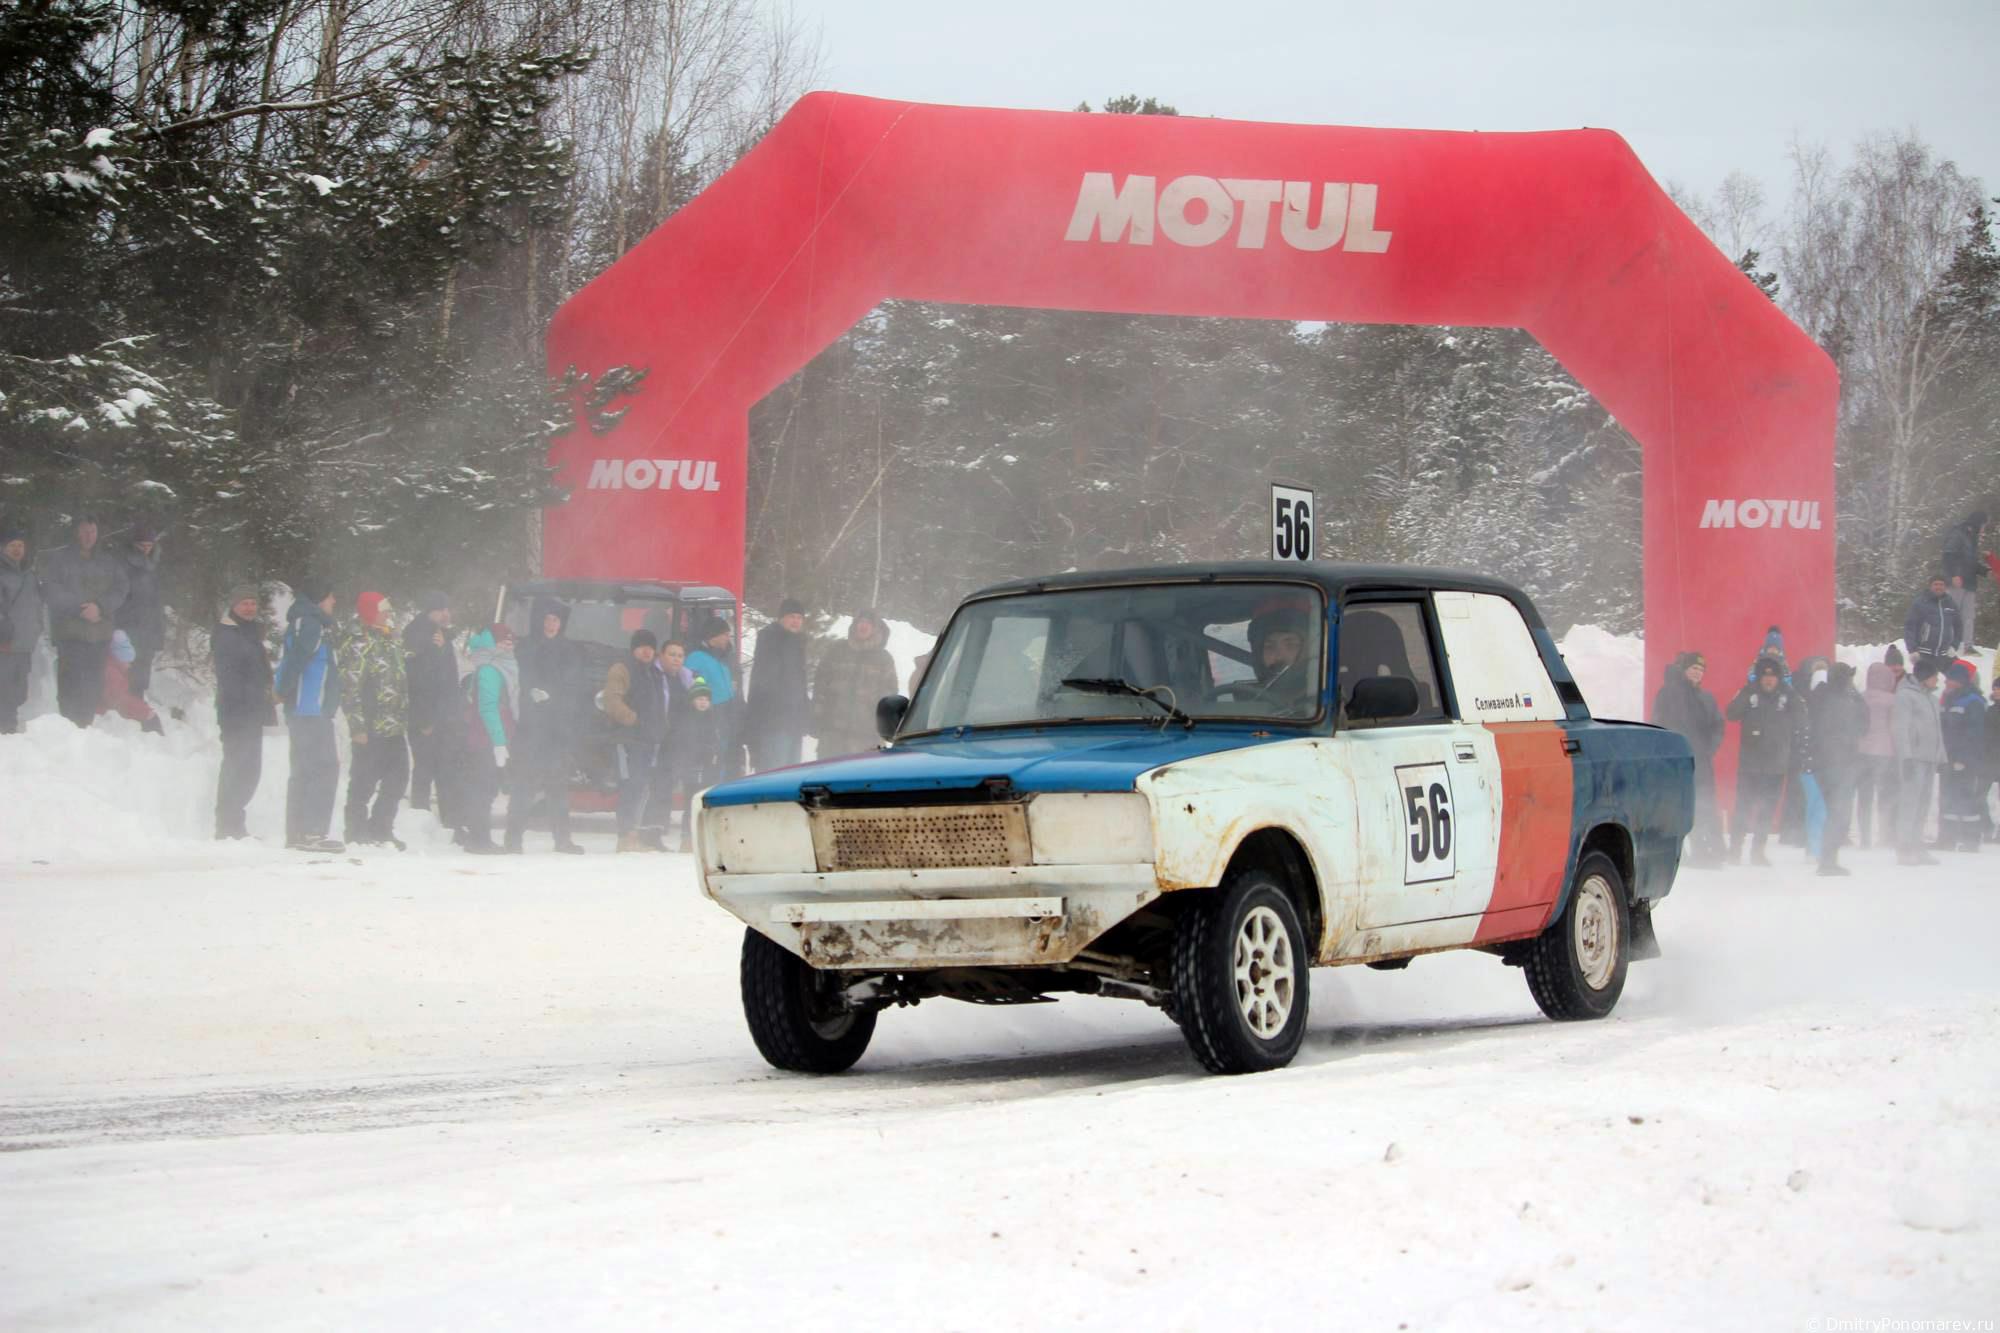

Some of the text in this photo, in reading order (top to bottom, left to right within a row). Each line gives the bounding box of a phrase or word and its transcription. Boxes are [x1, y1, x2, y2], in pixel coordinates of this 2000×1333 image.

[1064, 172, 1393, 254] MOTUL
[587, 459, 721, 492] MOTUL
[1276, 497, 1310, 561] 56
[1699, 498, 1822, 530] MOTUL
[1475, 697, 1515, 711] Селиванов
[1405, 782, 1452, 863] 56
